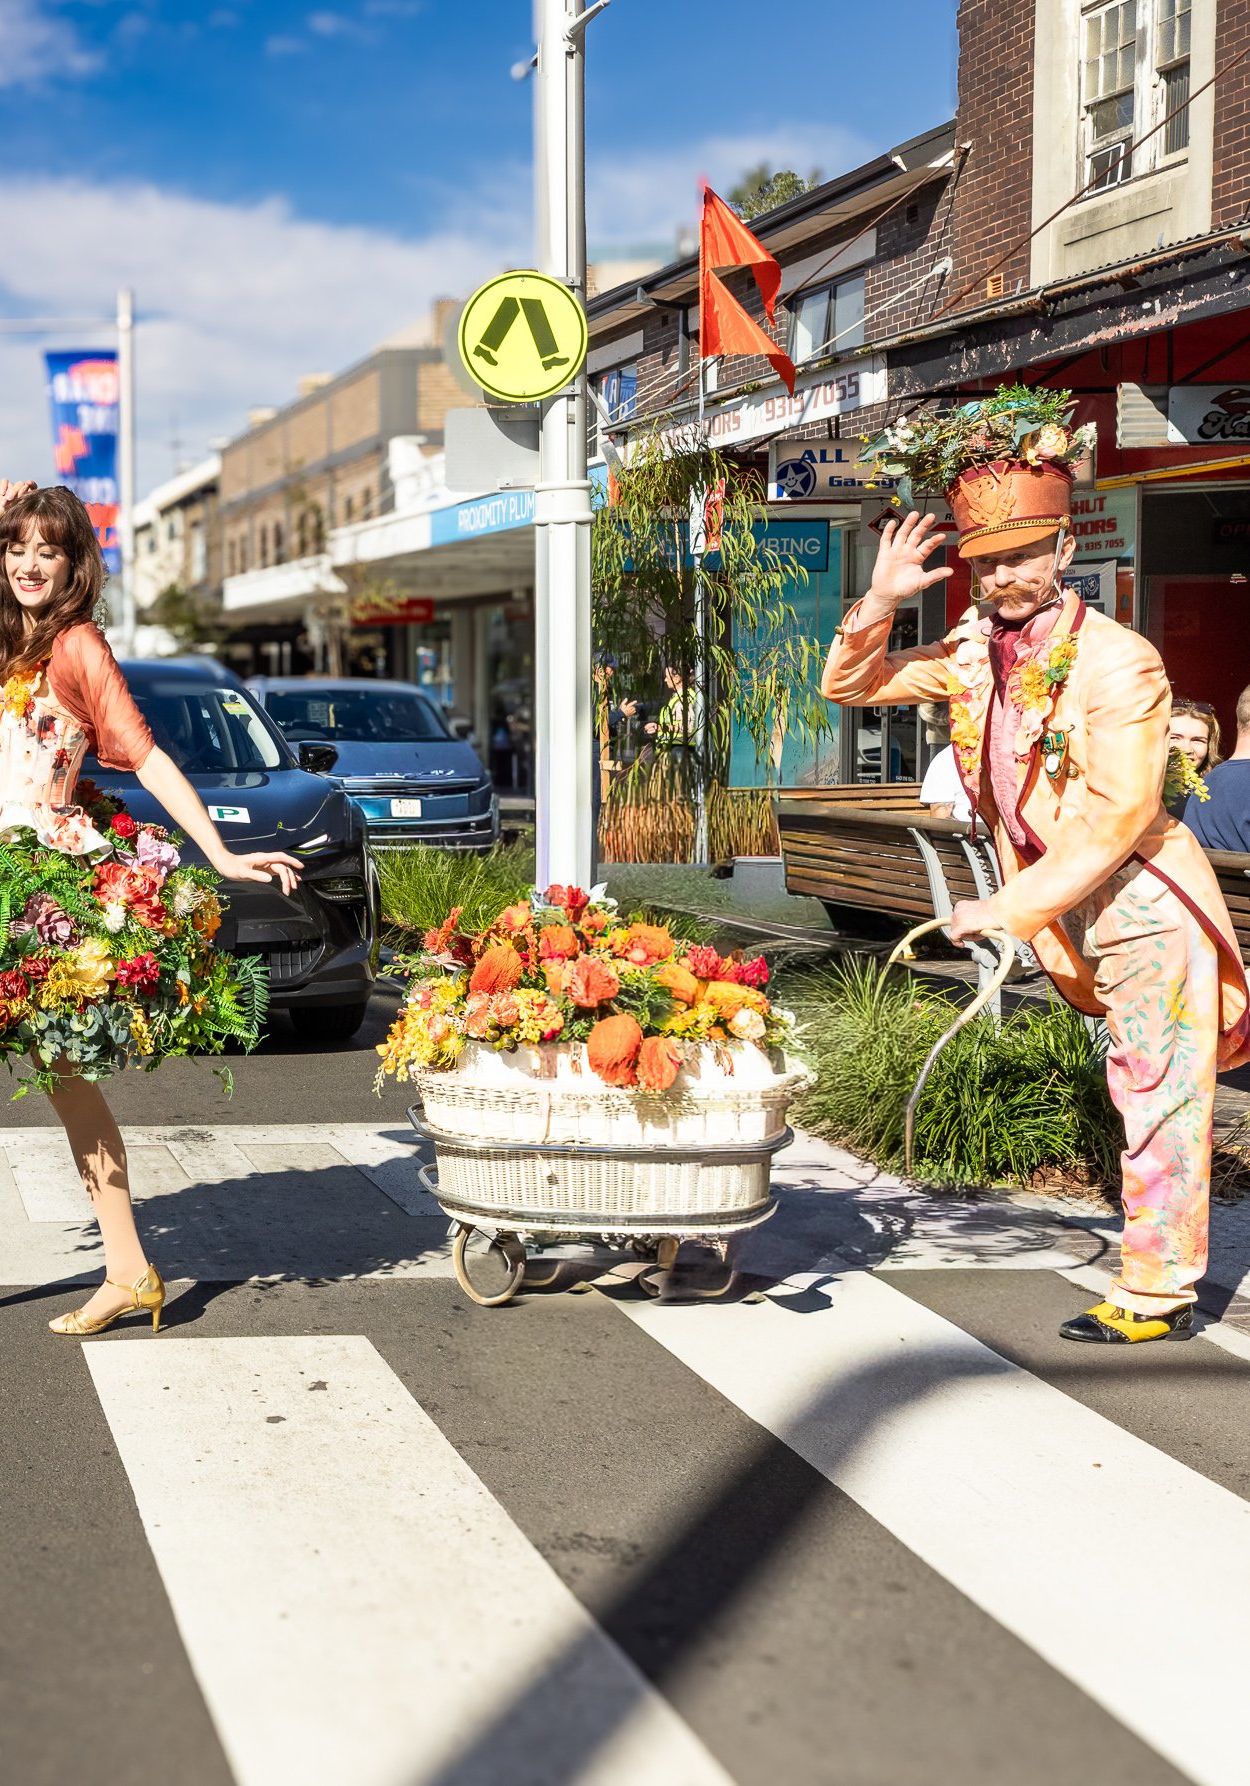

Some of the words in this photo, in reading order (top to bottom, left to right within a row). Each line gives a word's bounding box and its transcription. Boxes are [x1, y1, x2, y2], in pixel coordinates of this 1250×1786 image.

[765, 389, 805, 421] 9315
[811, 371, 860, 409] 7055
[799, 449, 850, 464] ALL
[458, 502, 507, 532] PROXIMITY
[1085, 541, 1102, 551] 9315
[1104, 538, 1125, 549] 7055
[216, 807, 240, 819] P
